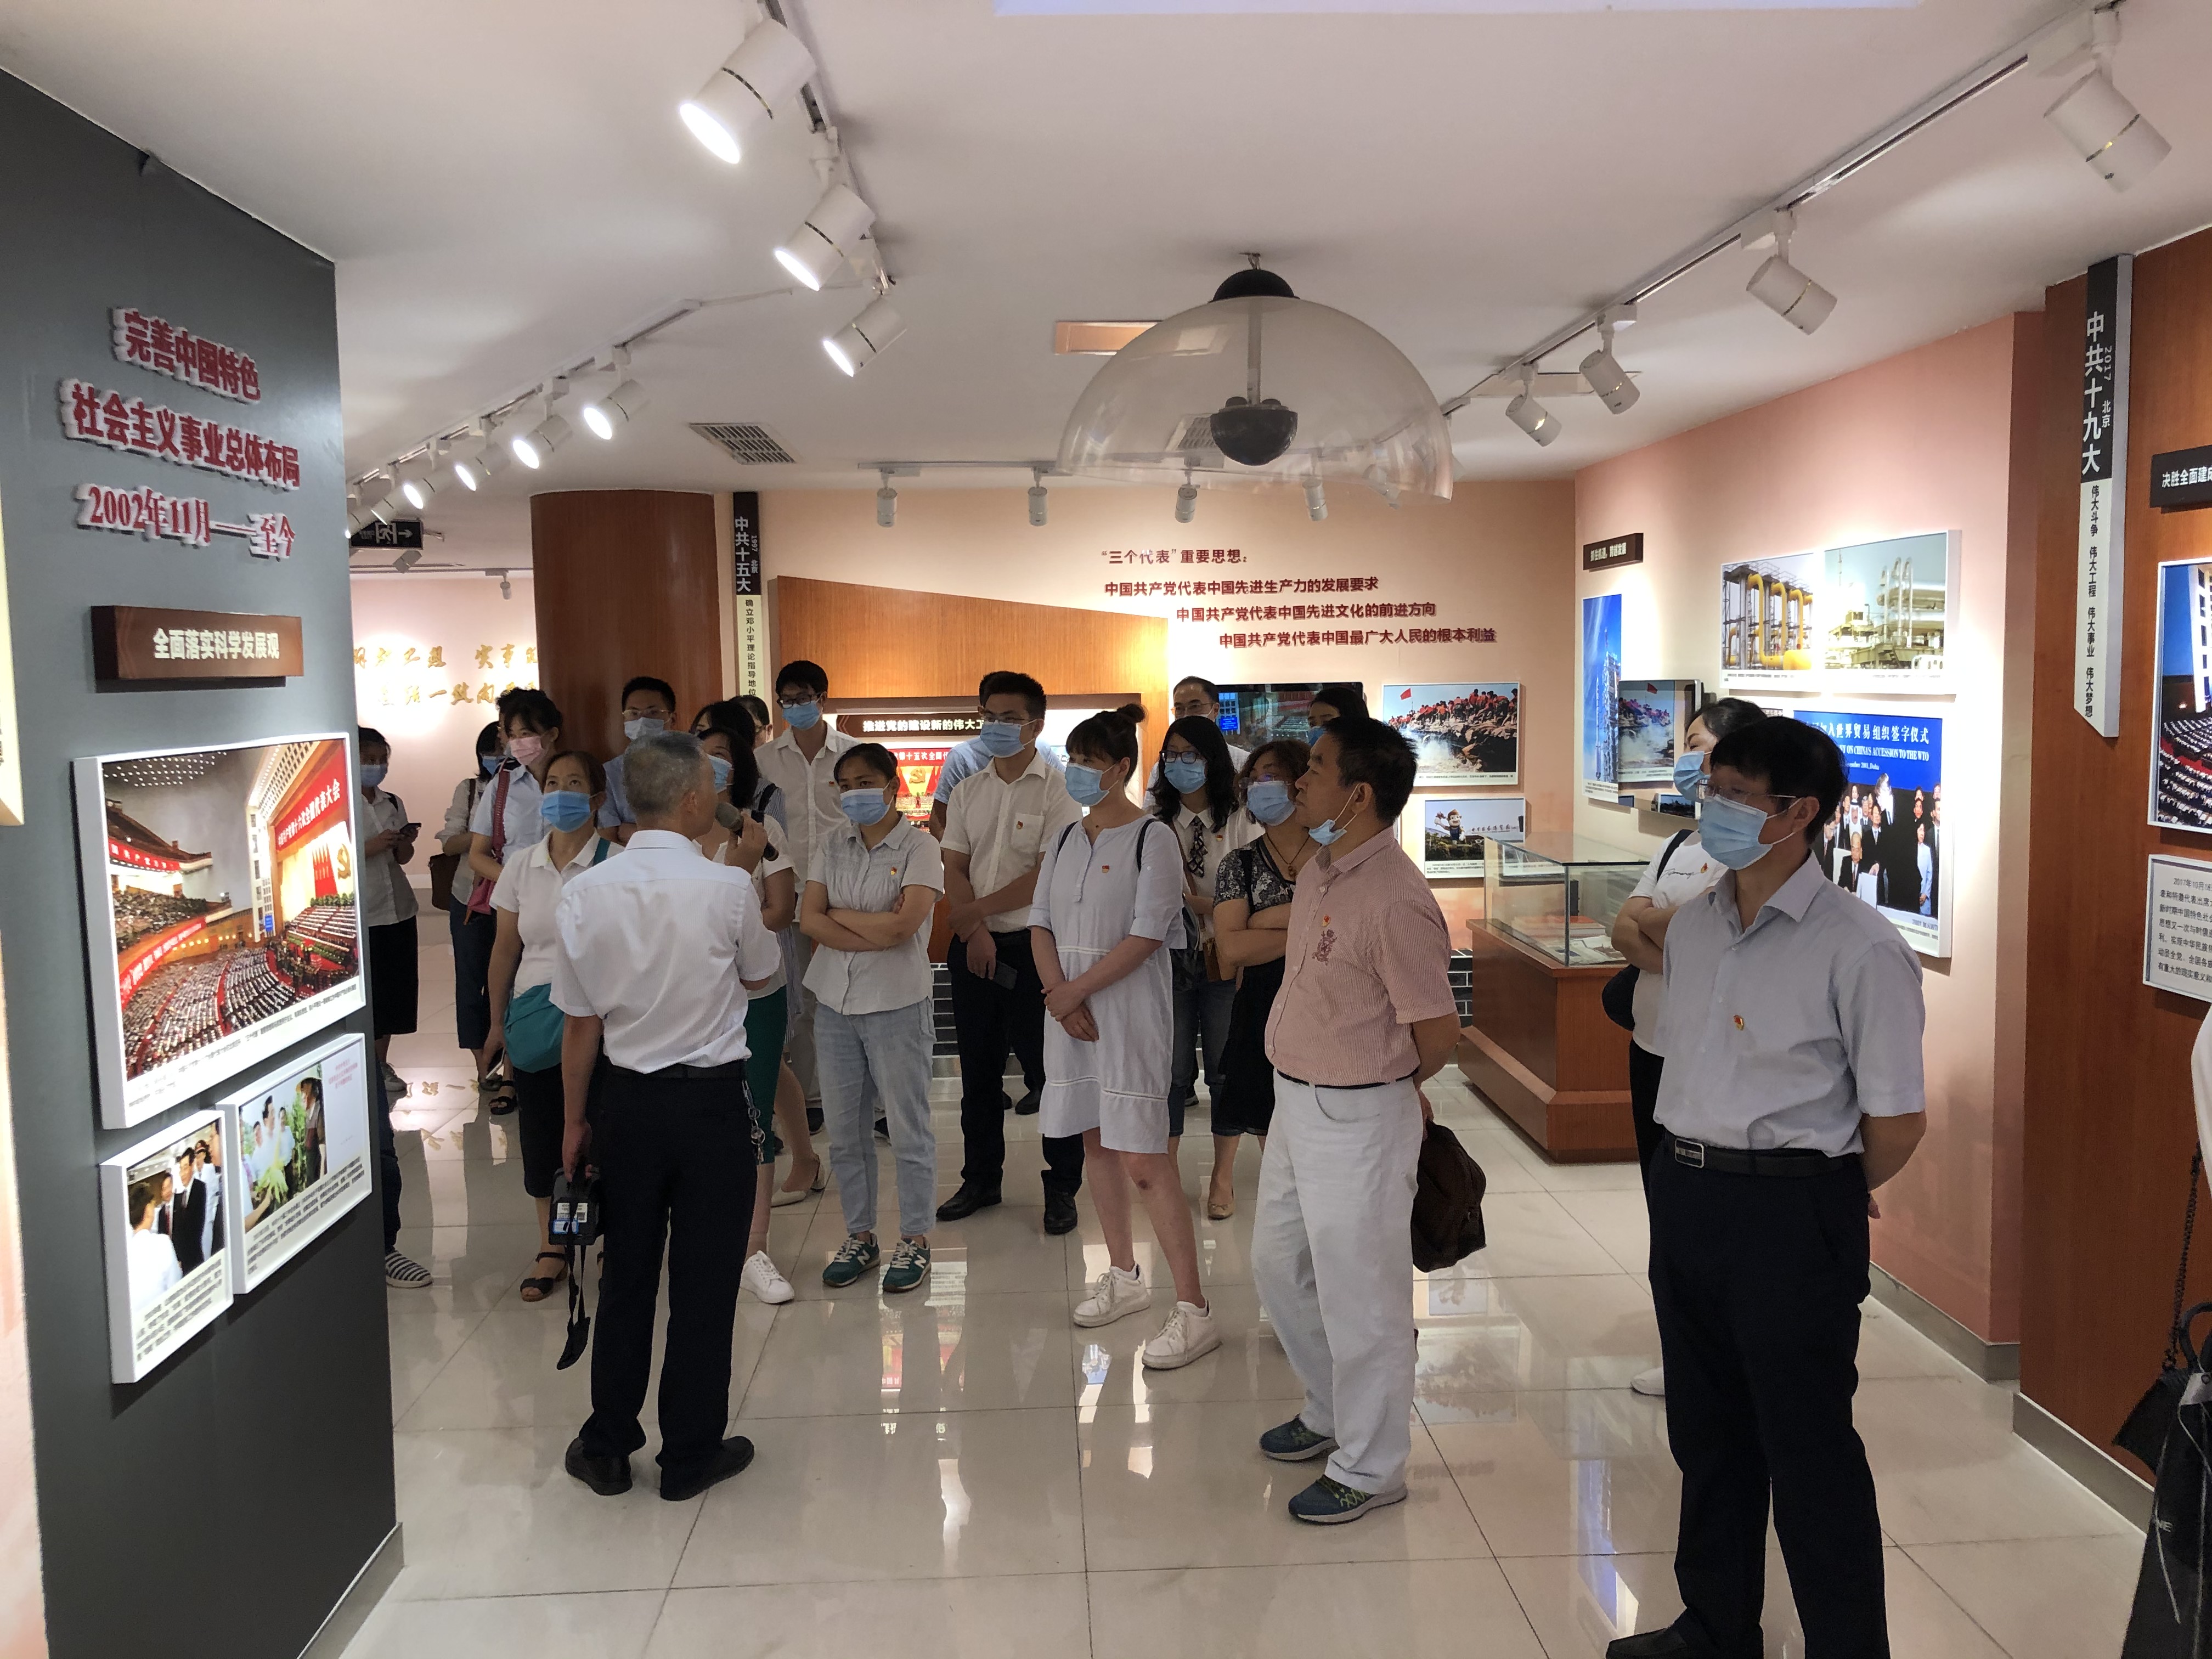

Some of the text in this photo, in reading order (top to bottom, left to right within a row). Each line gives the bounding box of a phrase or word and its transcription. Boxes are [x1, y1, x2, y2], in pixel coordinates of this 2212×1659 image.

[123, 310, 261, 401] 完善中国特色
[2104, 345, 2112, 381] 2017
[2082, 311, 2104, 475] 中共十九大
[2102, 400, 2111, 428] 北京
[71, 383, 300, 488] 社会主义事业总体布局
[735, 516, 751, 592] 中共十五大
[1104, 576, 1379, 596] 中国共产党代表中国先进生产力的发展要求
[2085, 485, 2100, 717] 伟大斗争 伟大工程 伟大事业 伟大梦想
[1176, 602, 1437, 622] 中国共产党代表中国先进文化的前进方向
[153, 628, 280, 660] 全面落实科学发展观
[745, 599, 757, 697] 确立邓小平理论指导地位
[1219, 627, 1497, 649] 中国共产党代表中国最广大人民的根本利益
[1906, 749, 1917, 760] THE
[1917, 751, 1929, 761] WTO
[2174, 877, 2212, 891] 2017年10月18
